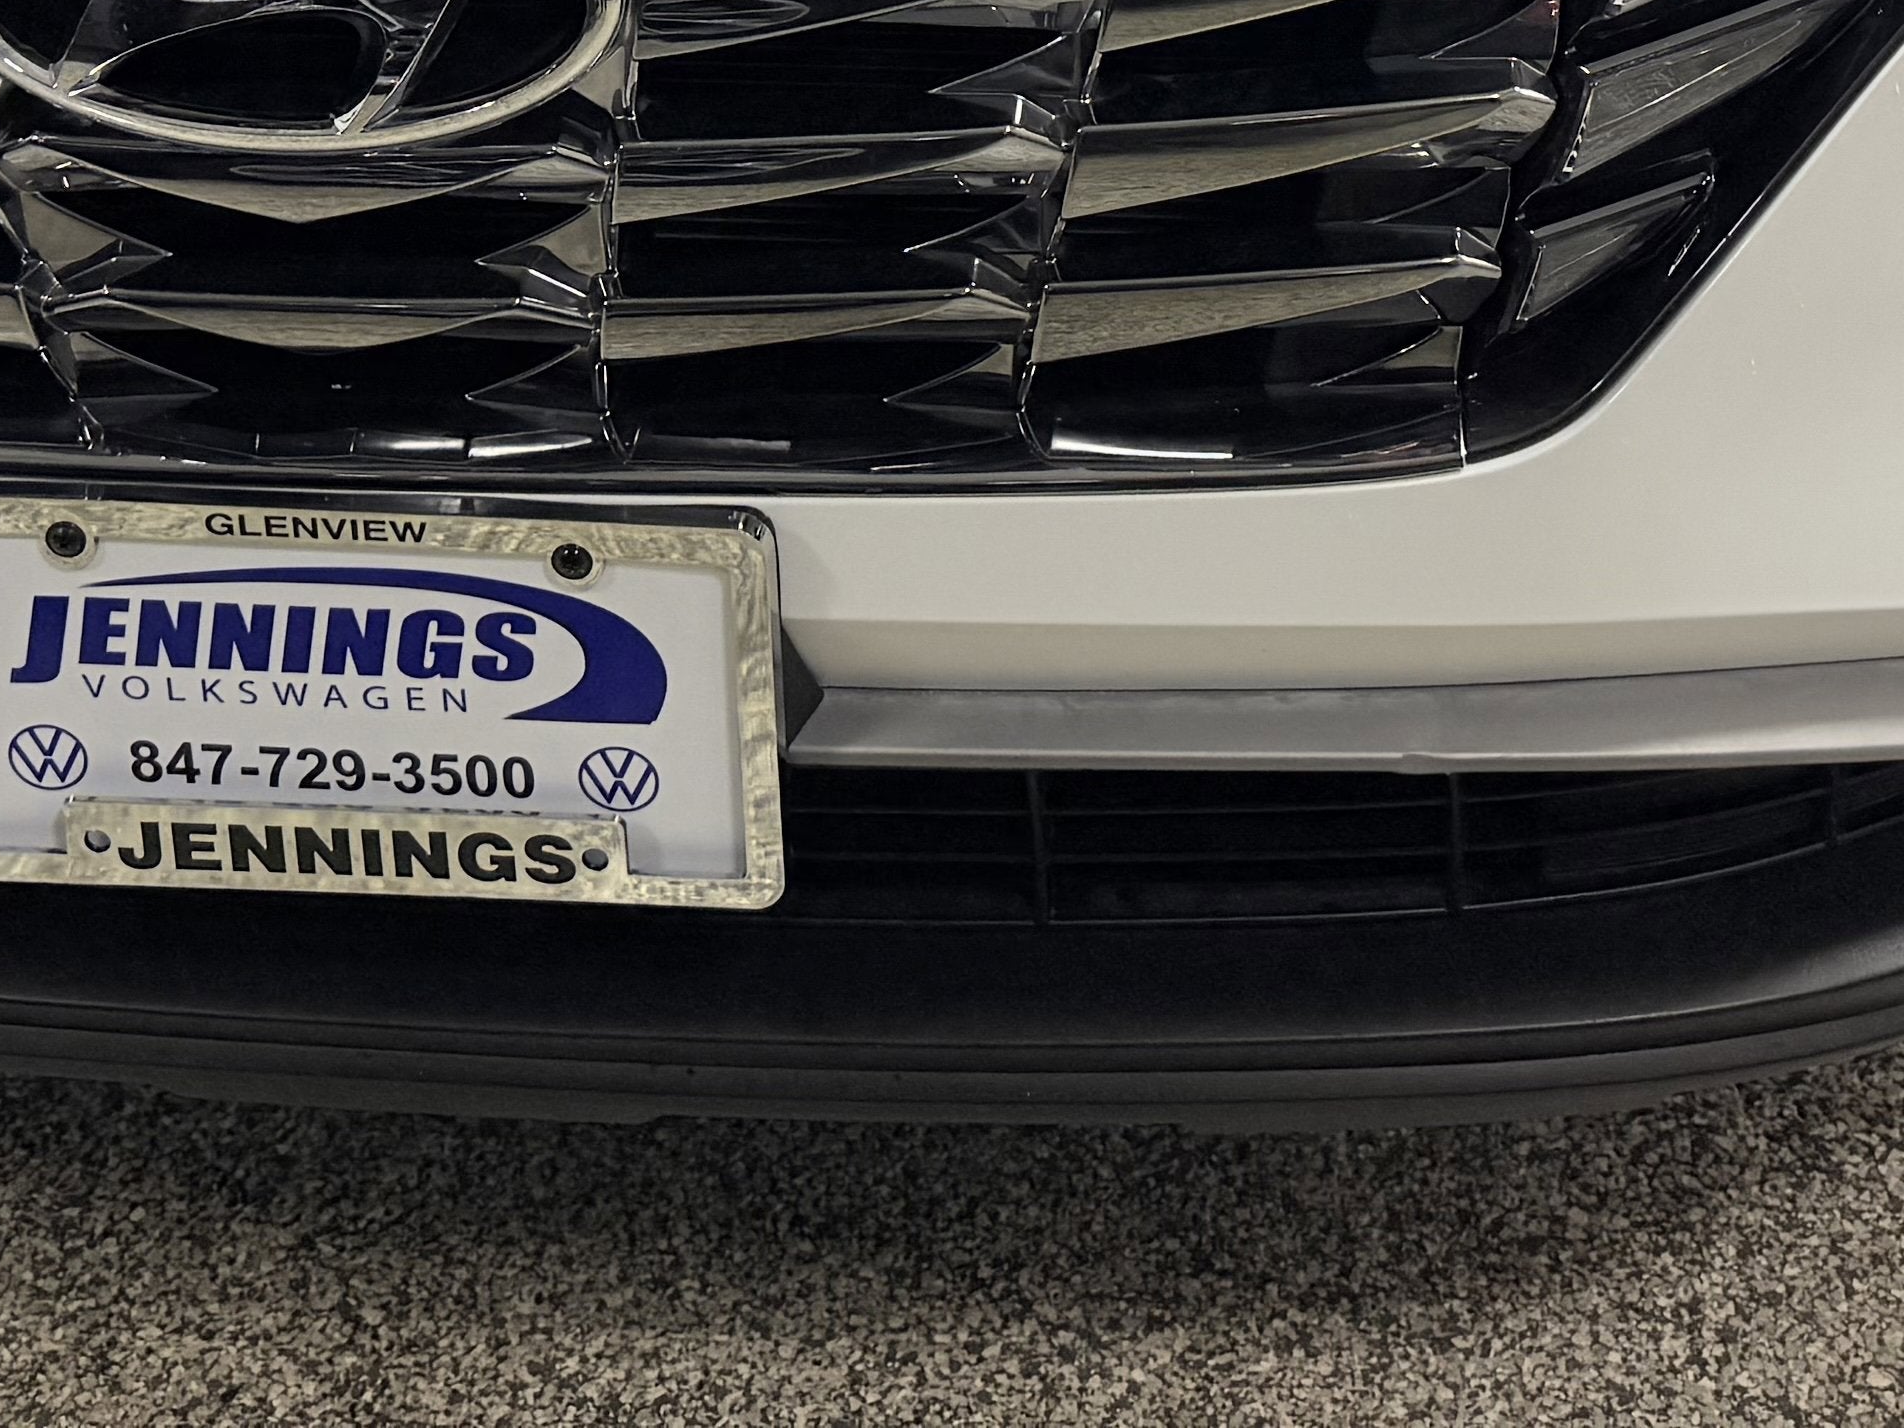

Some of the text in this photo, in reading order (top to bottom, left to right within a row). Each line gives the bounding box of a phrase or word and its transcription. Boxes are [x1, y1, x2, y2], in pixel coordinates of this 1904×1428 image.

[204, 513, 427, 543] GLENVIEW
[10, 595, 537, 684] JENNINGS
[81, 673, 469, 713] VOLKSWAGEN
[130, 740, 535, 799] 847-729-3500
[118, 821, 576, 884] JENNINGS
